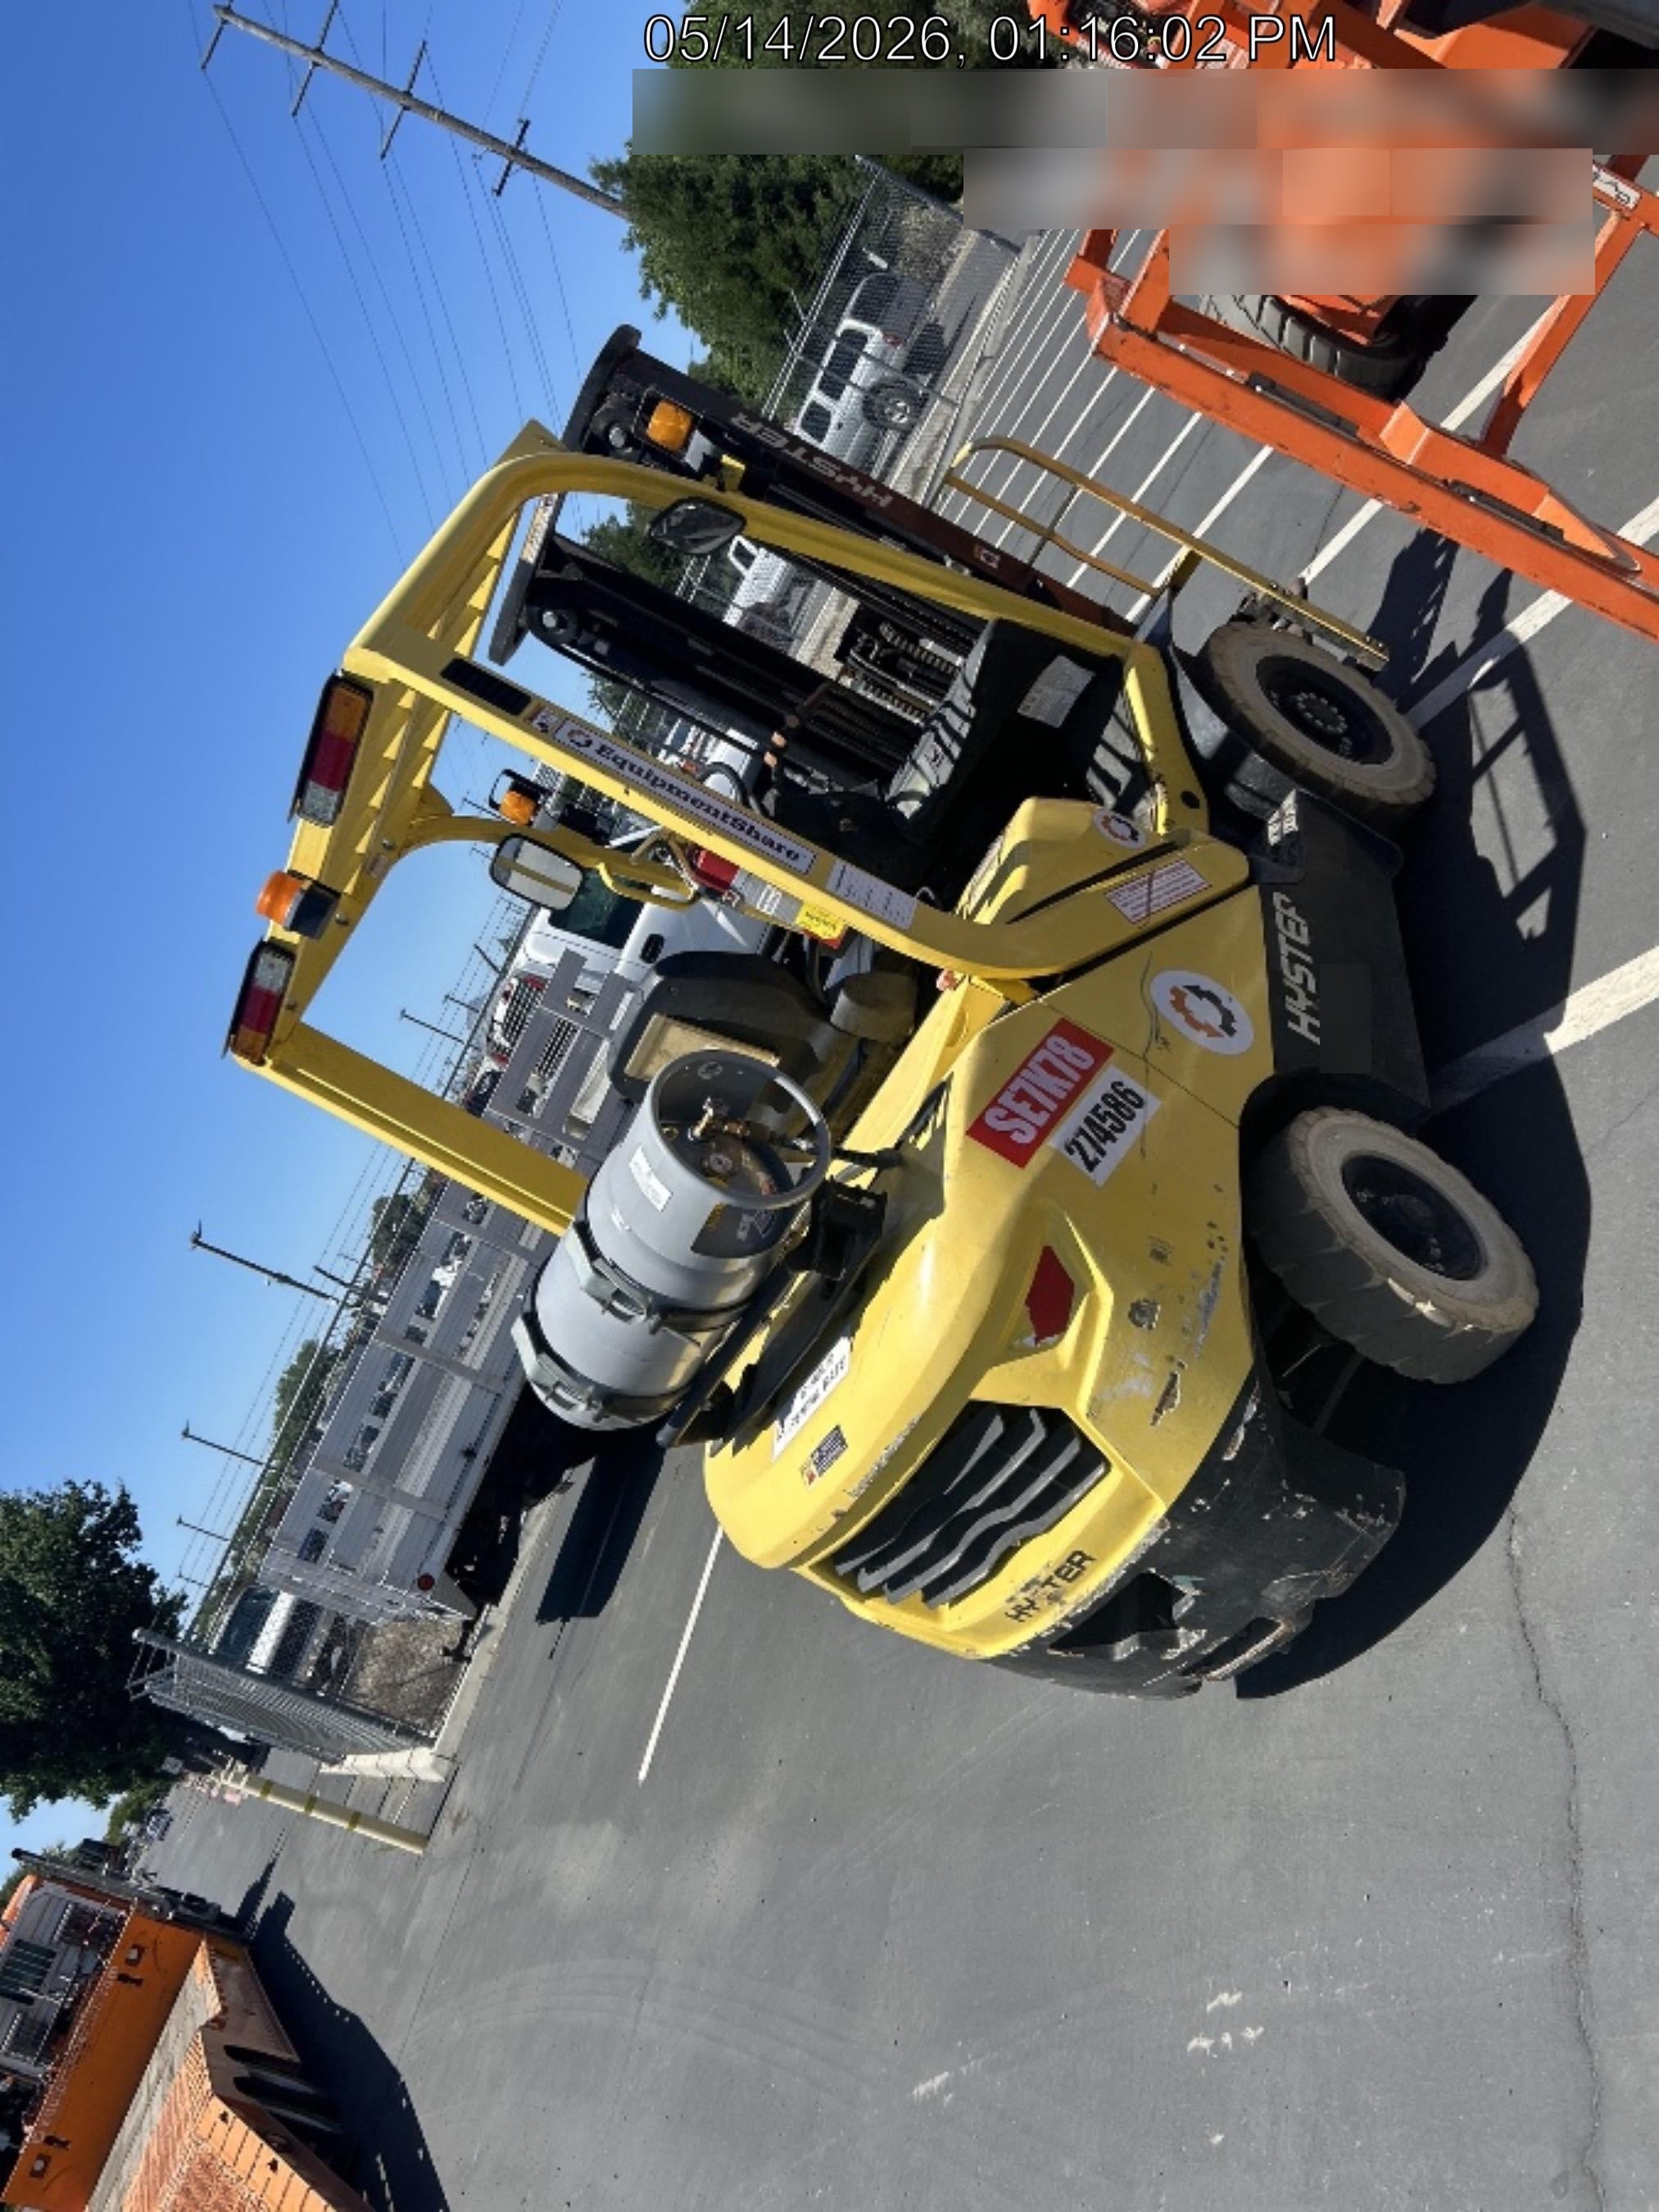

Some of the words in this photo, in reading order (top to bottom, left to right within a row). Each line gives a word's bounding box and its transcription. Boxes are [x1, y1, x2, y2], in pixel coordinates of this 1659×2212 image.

[732, 412, 893, 508] HYSTER
[596, 741, 800, 862] EquipmentShare
[1064, 1081, 1145, 1173] 274586
[1004, 1549, 1096, 1623] HYTER
